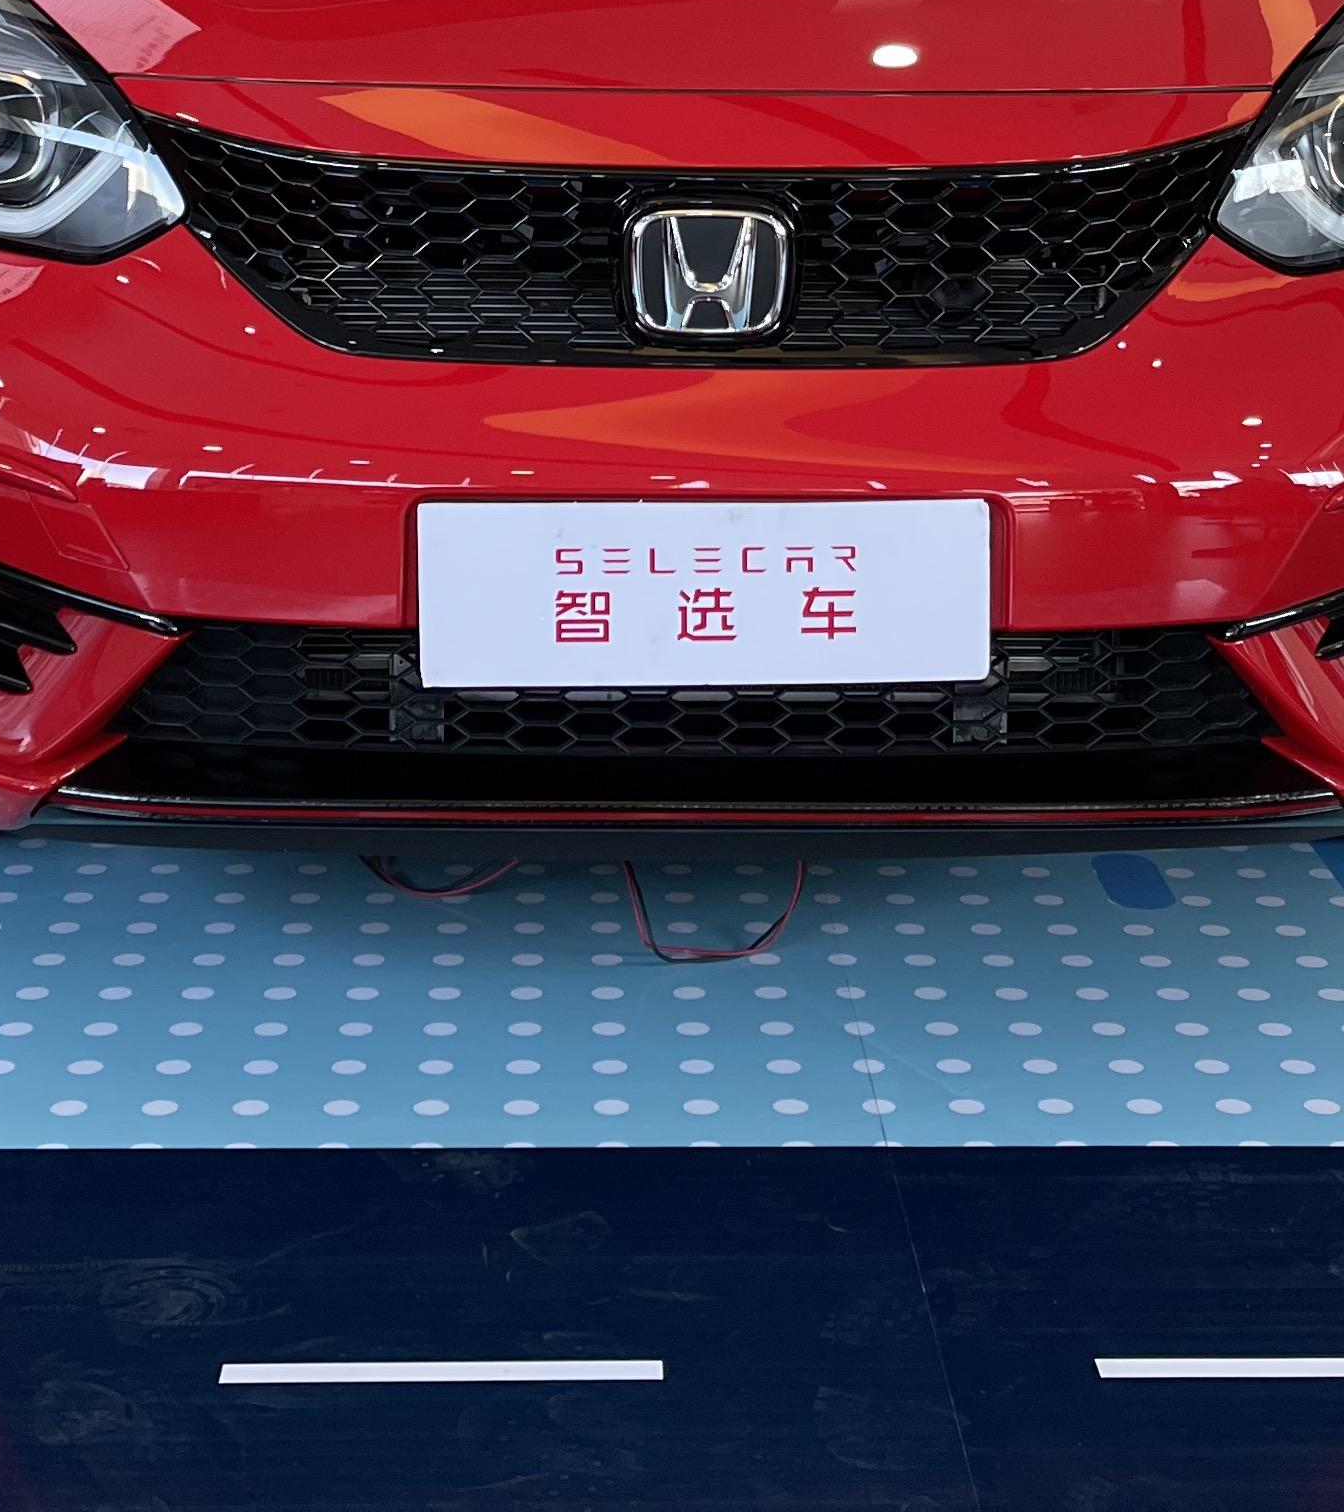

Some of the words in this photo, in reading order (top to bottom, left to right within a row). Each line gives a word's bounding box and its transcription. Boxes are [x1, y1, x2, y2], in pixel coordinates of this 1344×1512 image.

[555, 545, 857, 575] SELECAR
[555, 585, 857, 642] 智选车
